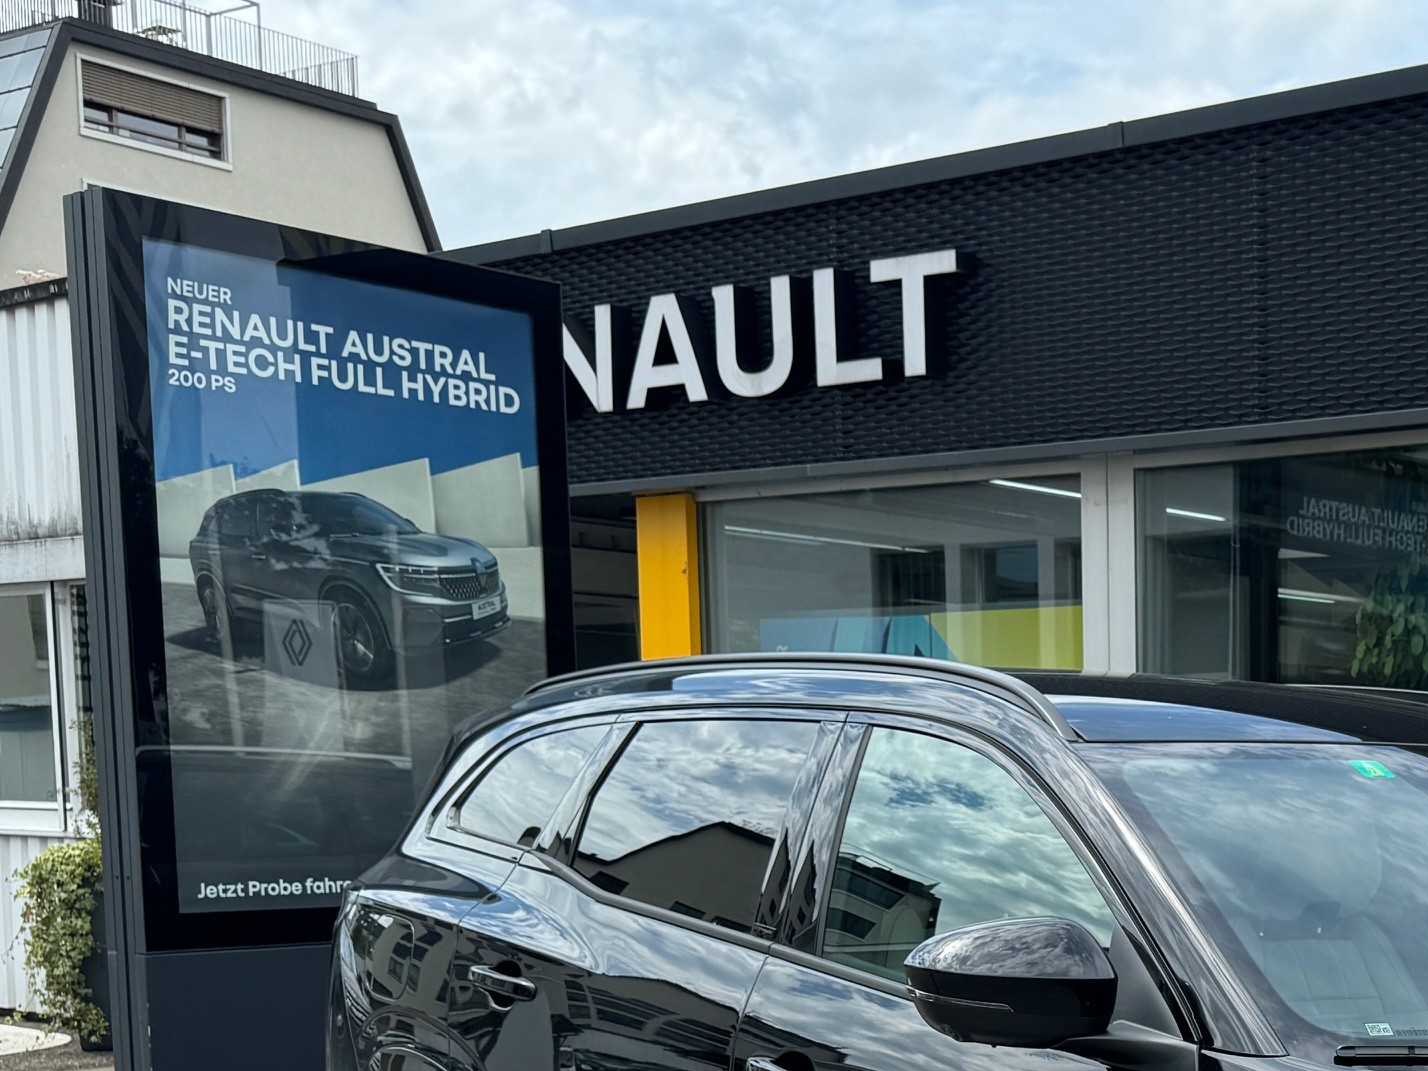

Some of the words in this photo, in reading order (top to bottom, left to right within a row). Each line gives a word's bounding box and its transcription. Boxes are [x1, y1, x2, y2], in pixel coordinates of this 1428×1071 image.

[166, 277, 232, 305] NEUER
[167, 299, 334, 354] RENAULT
[341, 330, 496, 382] AUSTRAL
[168, 334, 302, 383] E-TECH
[310, 356, 395, 397] FULL
[402, 370, 521, 415] HYBRID
[168, 368, 207, 389] 200
[210, 374, 236, 393] PS
[198, 882, 245, 899] Jetzt
[248, 879, 302, 896] Probe
